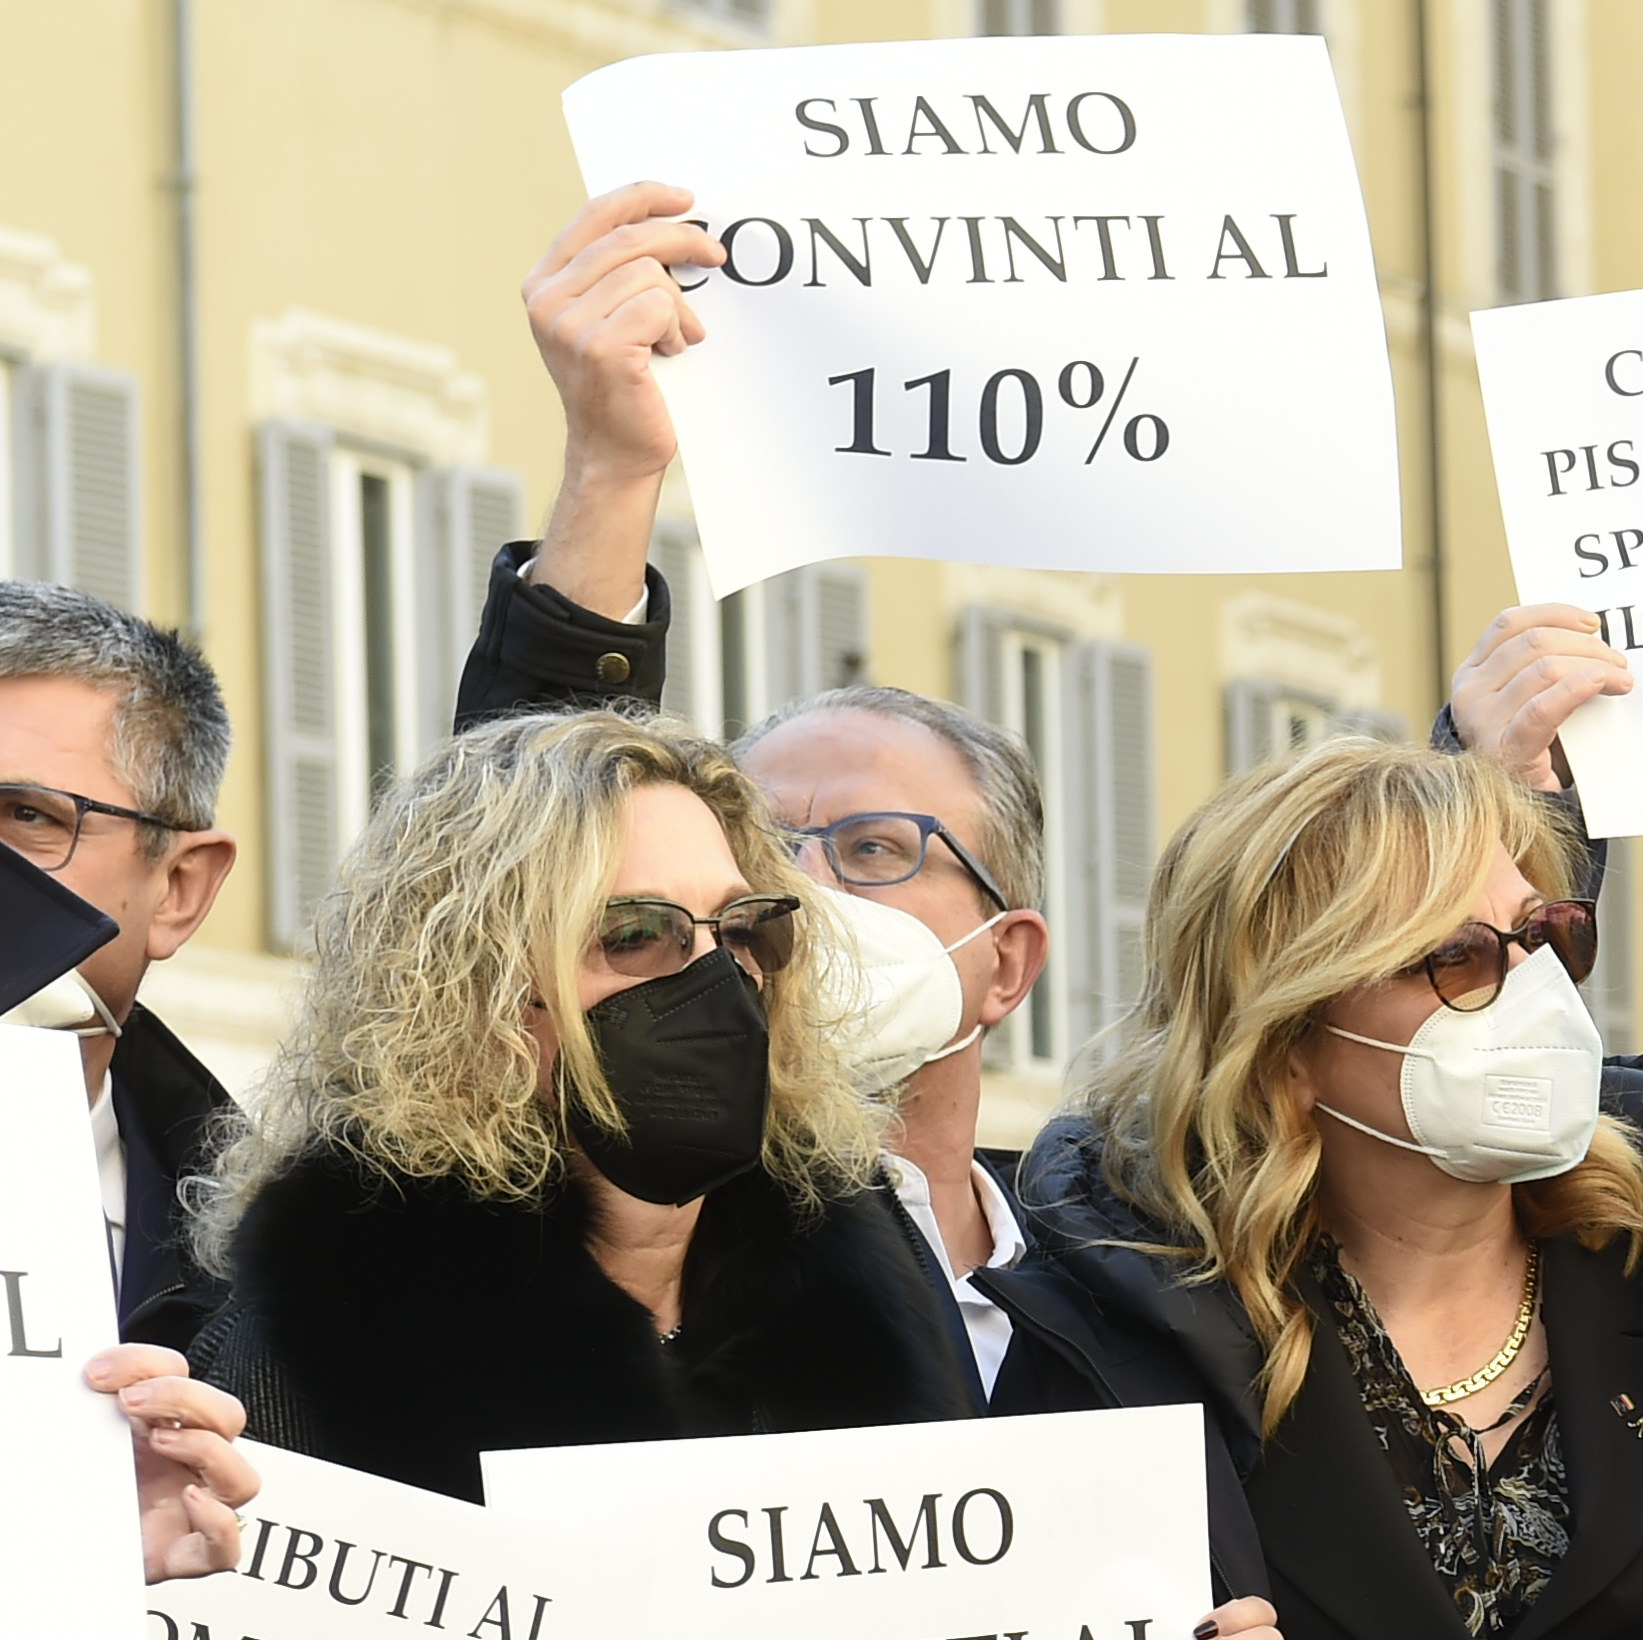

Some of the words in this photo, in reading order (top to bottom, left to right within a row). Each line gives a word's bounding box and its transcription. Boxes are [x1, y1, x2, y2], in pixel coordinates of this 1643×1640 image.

[794, 91, 1137, 158] SIAMO
[1206, 213, 1329, 280] AL
[827, 356, 1170, 466] 110%
[0, 1269, 63, 1359] L
[241, 1517, 460, 1630] IBUTI
[707, 1487, 1014, 1589] SIAMO
